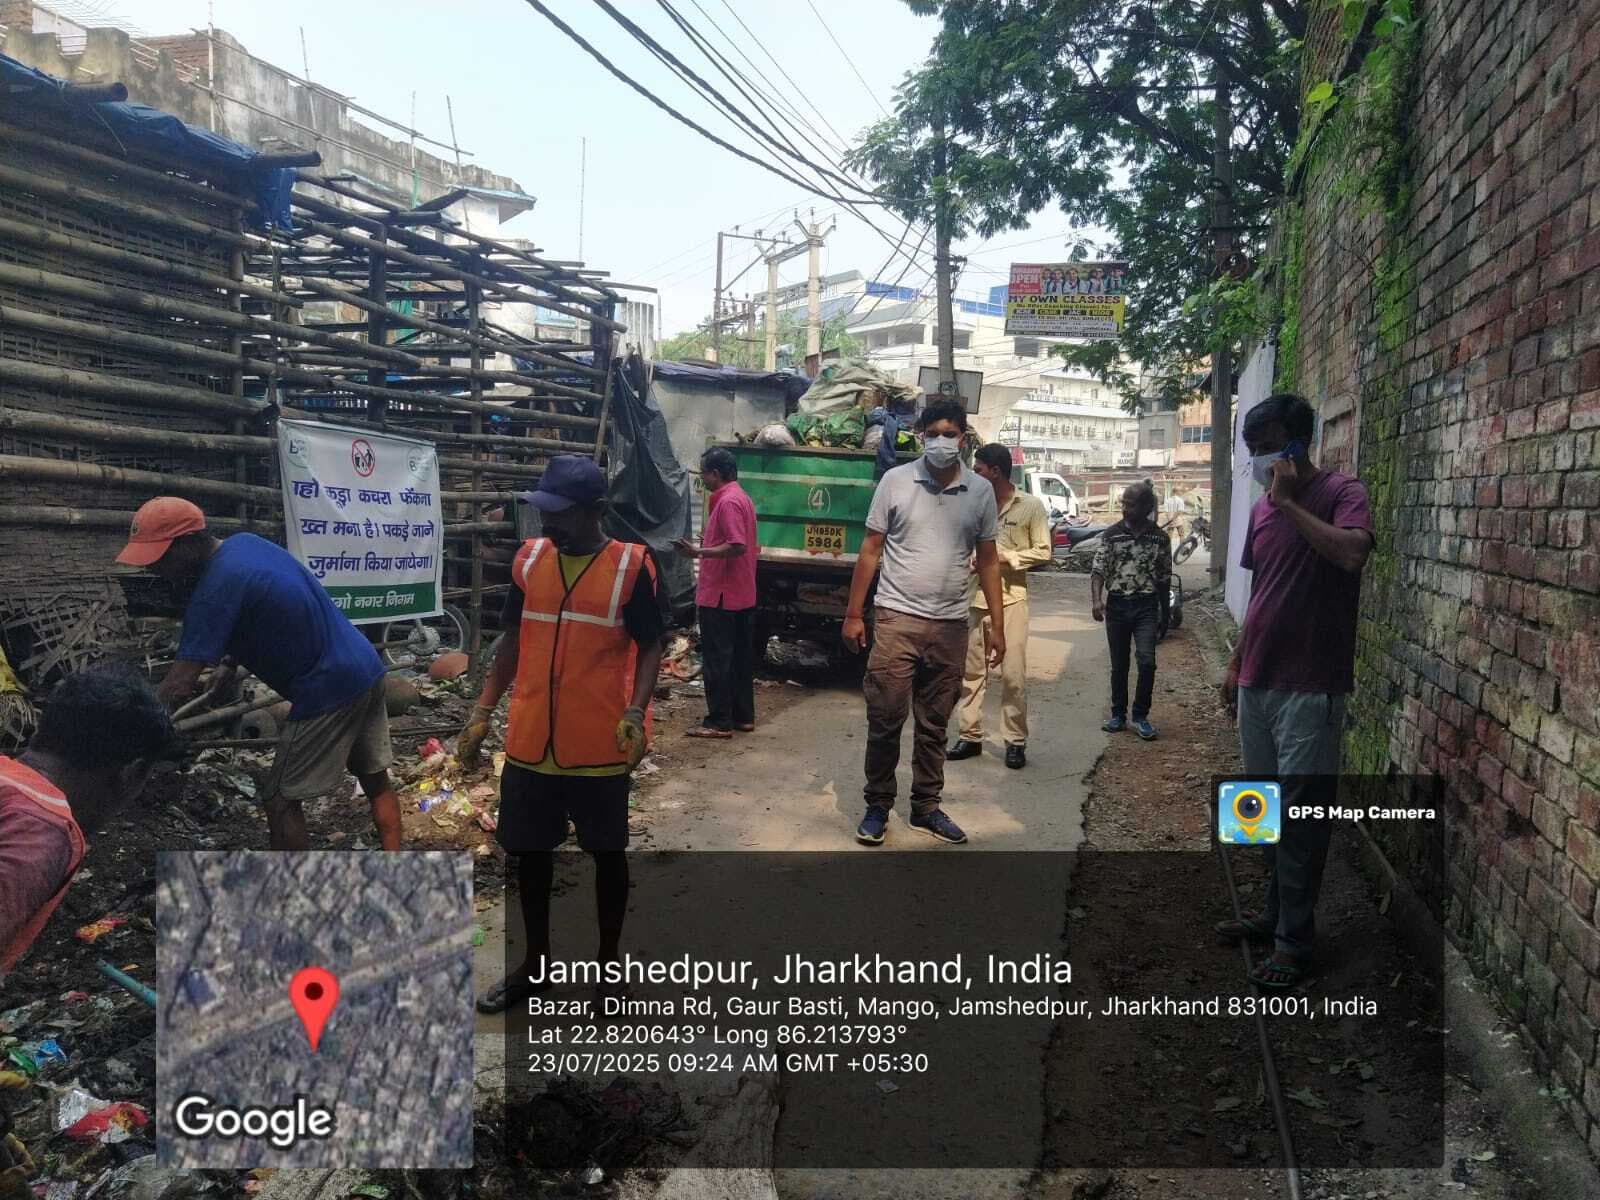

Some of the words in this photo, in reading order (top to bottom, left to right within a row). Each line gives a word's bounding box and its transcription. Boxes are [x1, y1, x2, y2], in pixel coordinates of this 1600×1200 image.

[1009, 295, 1025, 303] MY
[1030, 295, 1058, 303] OWN
[1063, 295, 1121, 304] CLASSES
[358, 489, 392, 506] कचरा
[399, 487, 432, 507] फेंकना
[333, 521, 361, 537] मना
[382, 520, 410, 542] पकड़े
[412, 520, 435, 539] जाने
[807, 527, 842, 537] JH05DK
[807, 537, 842, 549] 5984
[307, 551, 361, 578] जुर्माना
[364, 552, 393, 572] किया
[354, 596, 385, 609] नगर
[385, 590, 416, 608] निगम
